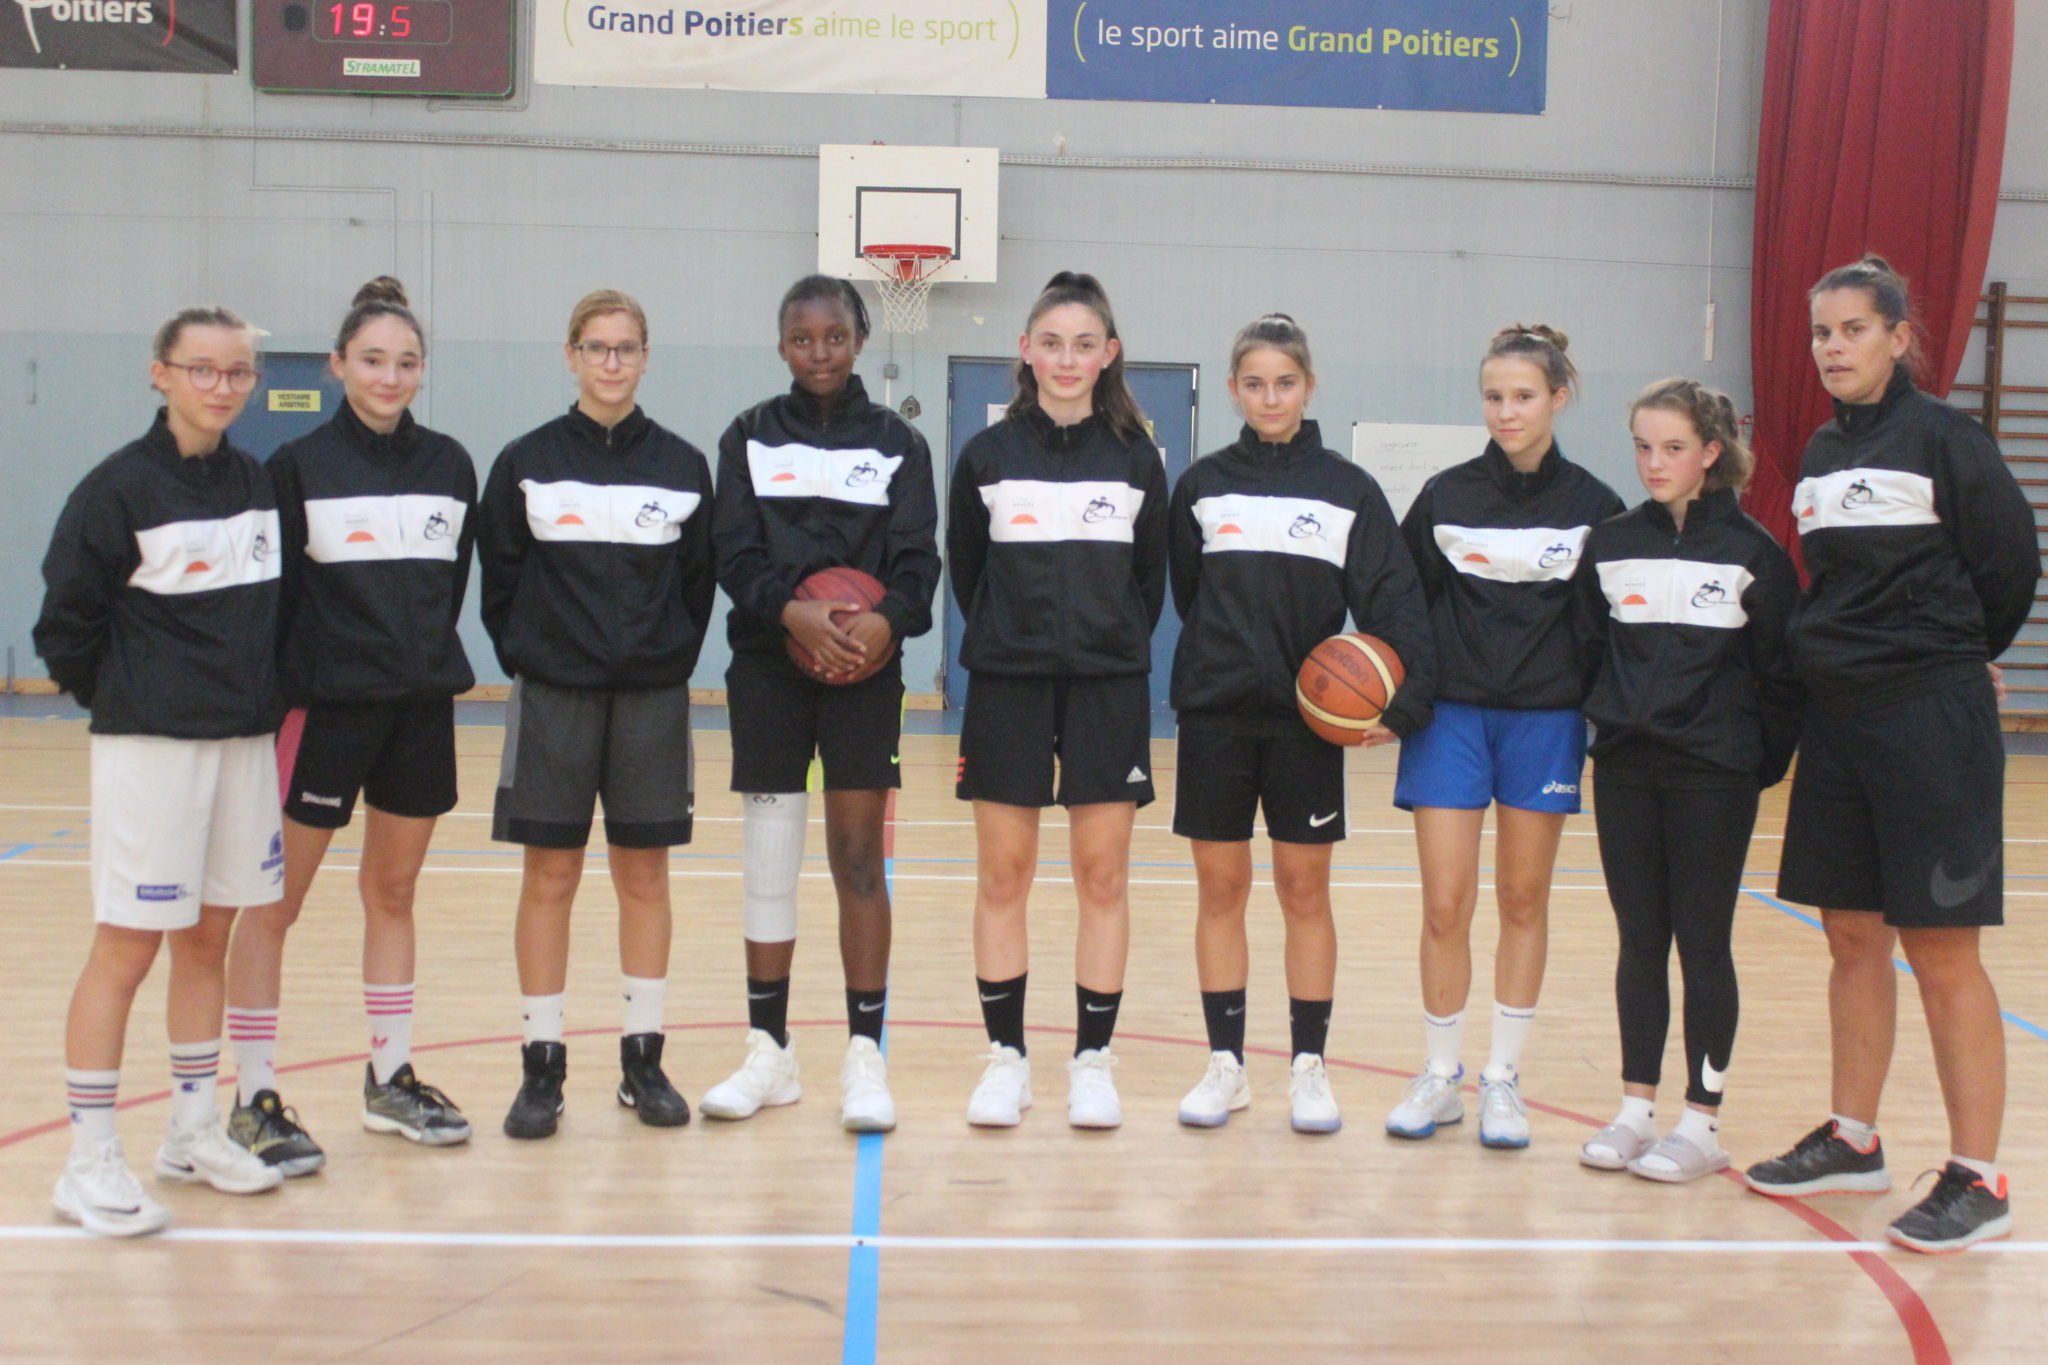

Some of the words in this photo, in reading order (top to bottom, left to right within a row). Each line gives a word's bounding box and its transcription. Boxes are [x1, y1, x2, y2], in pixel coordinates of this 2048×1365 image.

[587, 5, 674, 35] Grand
[684, 10, 803, 37] Poitiers
[813, 11, 881, 38] aime
[891, 14, 915, 39] le
[924, 17, 997, 45] sport
[1098, 18, 1121, 46] le
[1131, 24, 1204, 52] sport
[1213, 23, 1279, 50] aime
[1288, 25, 1372, 54] Grand
[1383, 28, 1500, 57] Poitiers
